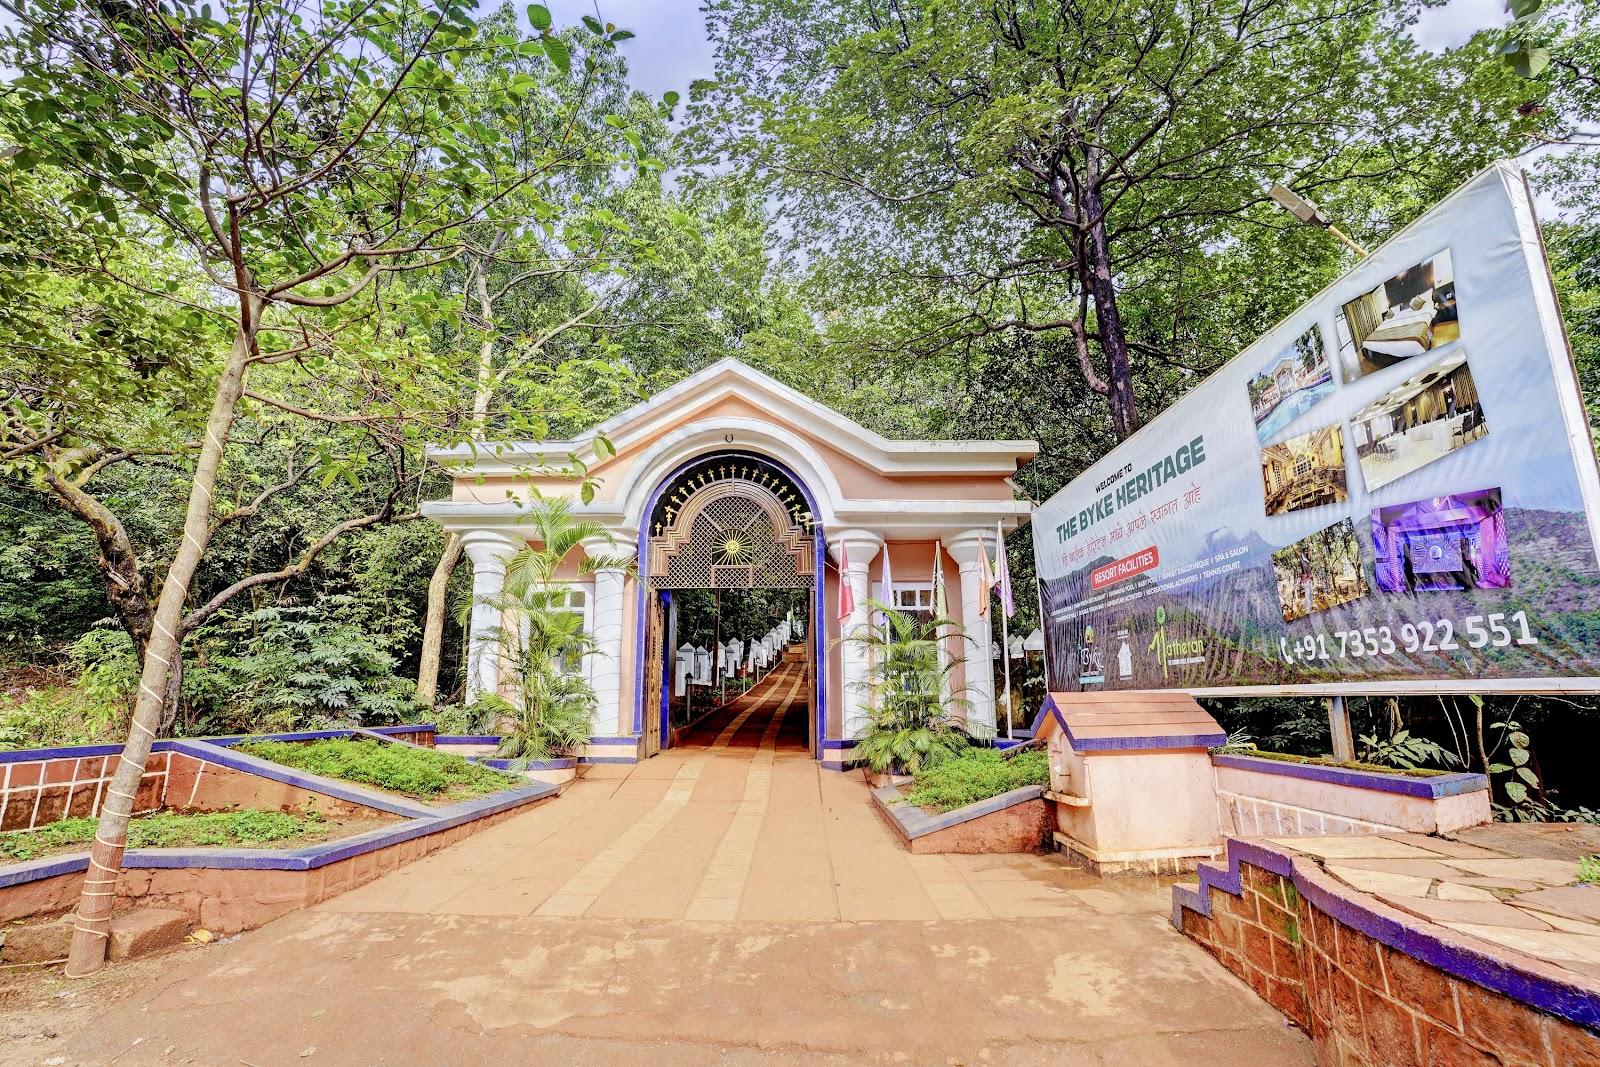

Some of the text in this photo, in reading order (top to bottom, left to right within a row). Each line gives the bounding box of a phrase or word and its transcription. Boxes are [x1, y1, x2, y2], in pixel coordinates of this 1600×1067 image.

[1056, 434, 1206, 544] THE BYKE HERITAGE
[1095, 462, 1133, 494] WELCOME TO
[1150, 498, 1179, 525] स्वागत
[1182, 481, 1202, 510] आहे
[1094, 550, 1154, 585] RESORT FACILITIES
[1161, 569, 1178, 580] SUNSET
[1214, 554, 1225, 563] SPA
[1230, 545, 1248, 558] SALON
[1175, 574, 1198, 587] ACTIVITIES
[1203, 567, 1222, 579] TENNIS
[1222, 560, 1241, 573] COURT
[1147, 626, 1205, 679] Matheran
[1293, 610, 1538, 662] +91 7353 922 551
